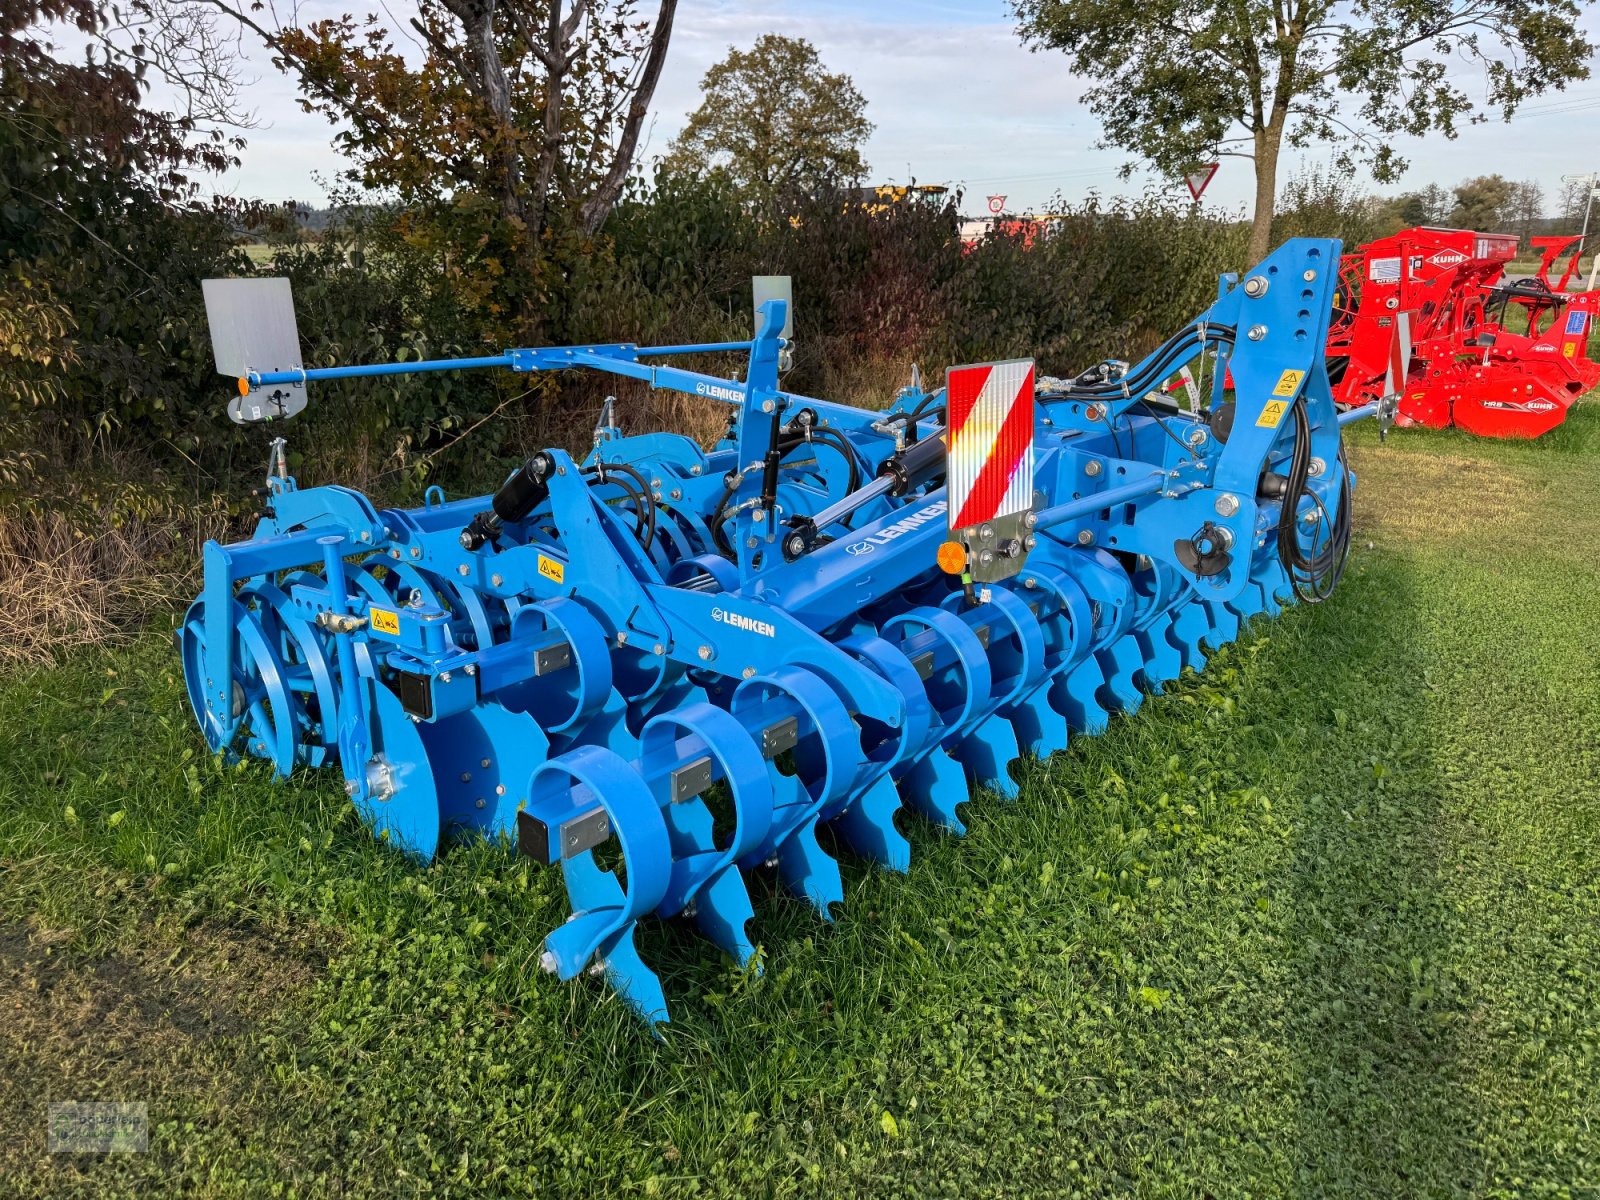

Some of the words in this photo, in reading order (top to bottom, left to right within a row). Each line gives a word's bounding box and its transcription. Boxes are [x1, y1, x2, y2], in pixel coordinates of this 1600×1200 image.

[1433, 255, 1463, 264] KUHN
[706, 384, 745, 403] LEMKEN
[1527, 402, 1553, 410] KUHN
[864, 500, 947, 545] LEMKEN
[723, 610, 775, 639] LEMKEN
